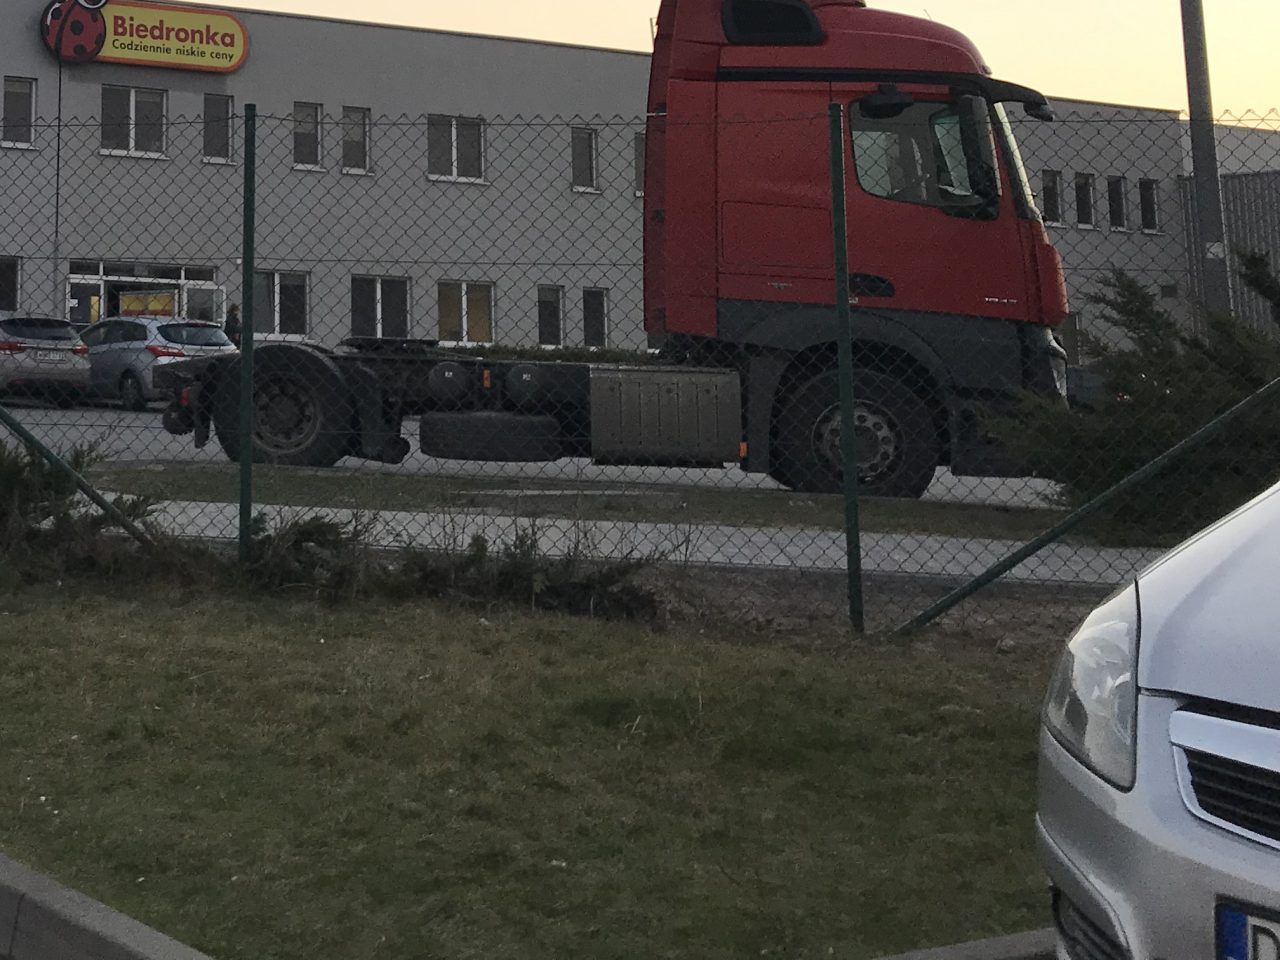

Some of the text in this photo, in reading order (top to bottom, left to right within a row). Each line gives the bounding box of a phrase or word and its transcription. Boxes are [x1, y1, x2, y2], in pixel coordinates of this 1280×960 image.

[113, 15, 235, 48] Biedronka
[112, 38, 234, 62] Codziennie niskie ceny
